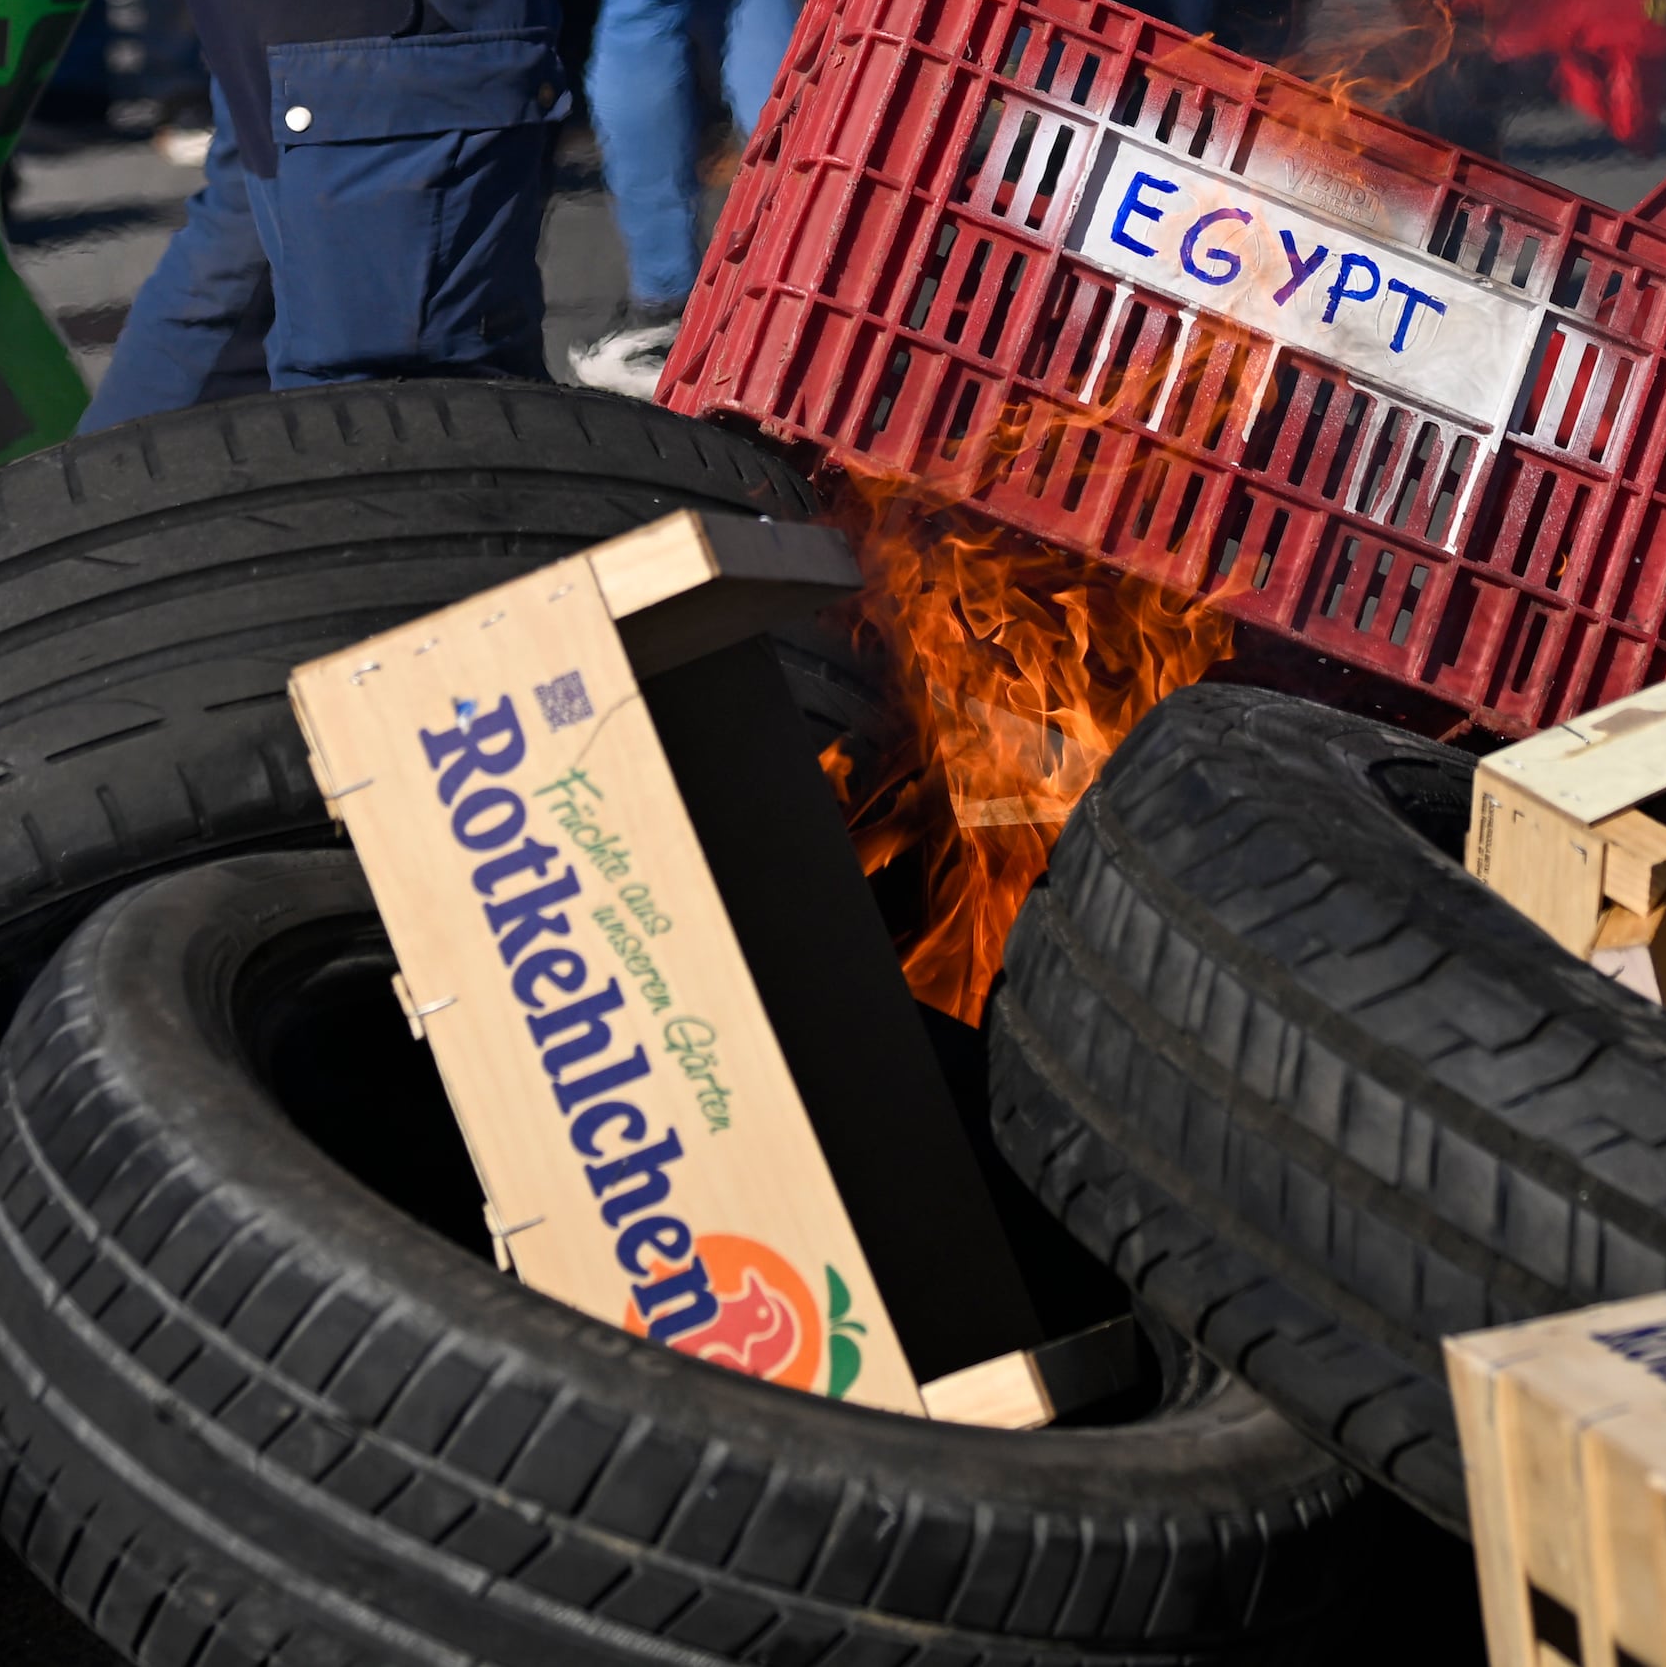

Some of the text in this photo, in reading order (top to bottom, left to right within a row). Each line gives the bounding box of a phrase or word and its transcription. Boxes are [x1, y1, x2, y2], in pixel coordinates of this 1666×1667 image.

[1108, 170, 1448, 355] EGYPT
[532, 765, 673, 939] Früchte aus
[419, 692, 722, 1348] Rotkehlchen
[590, 903, 732, 1136] unseren Gärten
